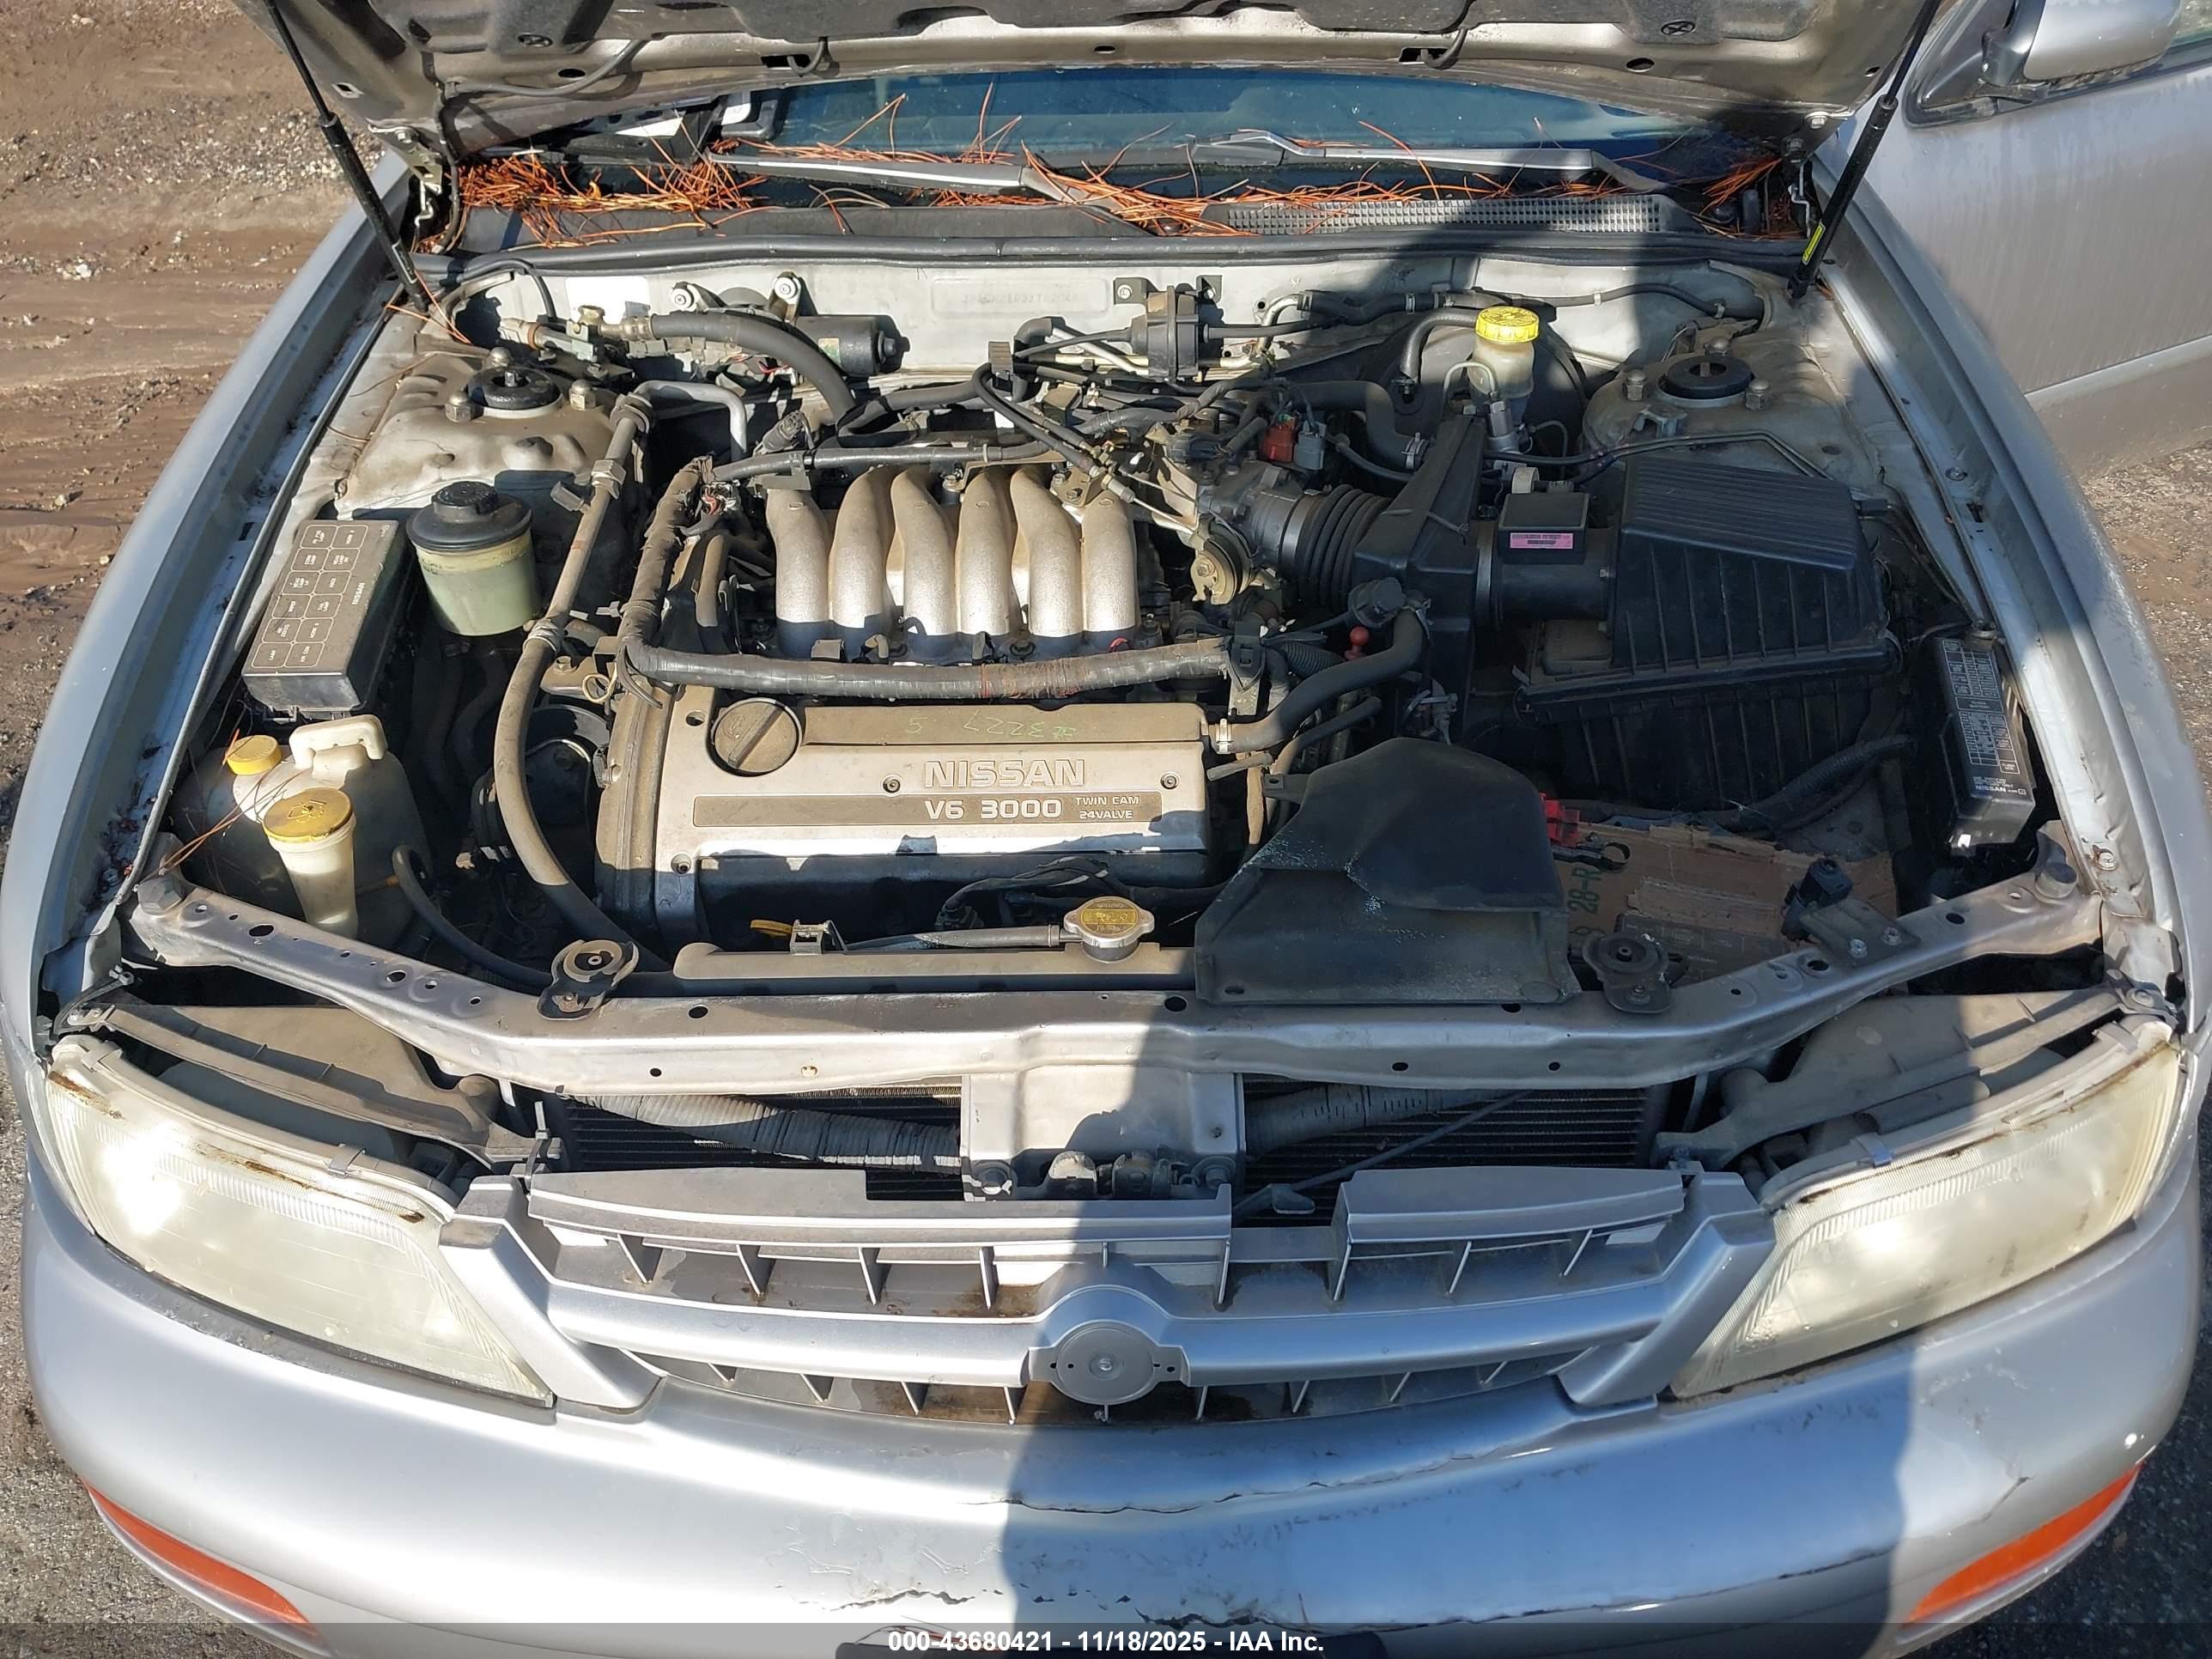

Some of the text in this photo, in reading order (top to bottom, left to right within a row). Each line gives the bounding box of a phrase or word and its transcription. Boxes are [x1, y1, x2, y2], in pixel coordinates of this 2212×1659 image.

[352, 583, 365, 605] NISSAN
[924, 759, 1086, 788] NISSAN
[925, 795, 1139, 819] V6 3000 TWIN CAM
[1079, 810, 1133, 820] 24VALVE
